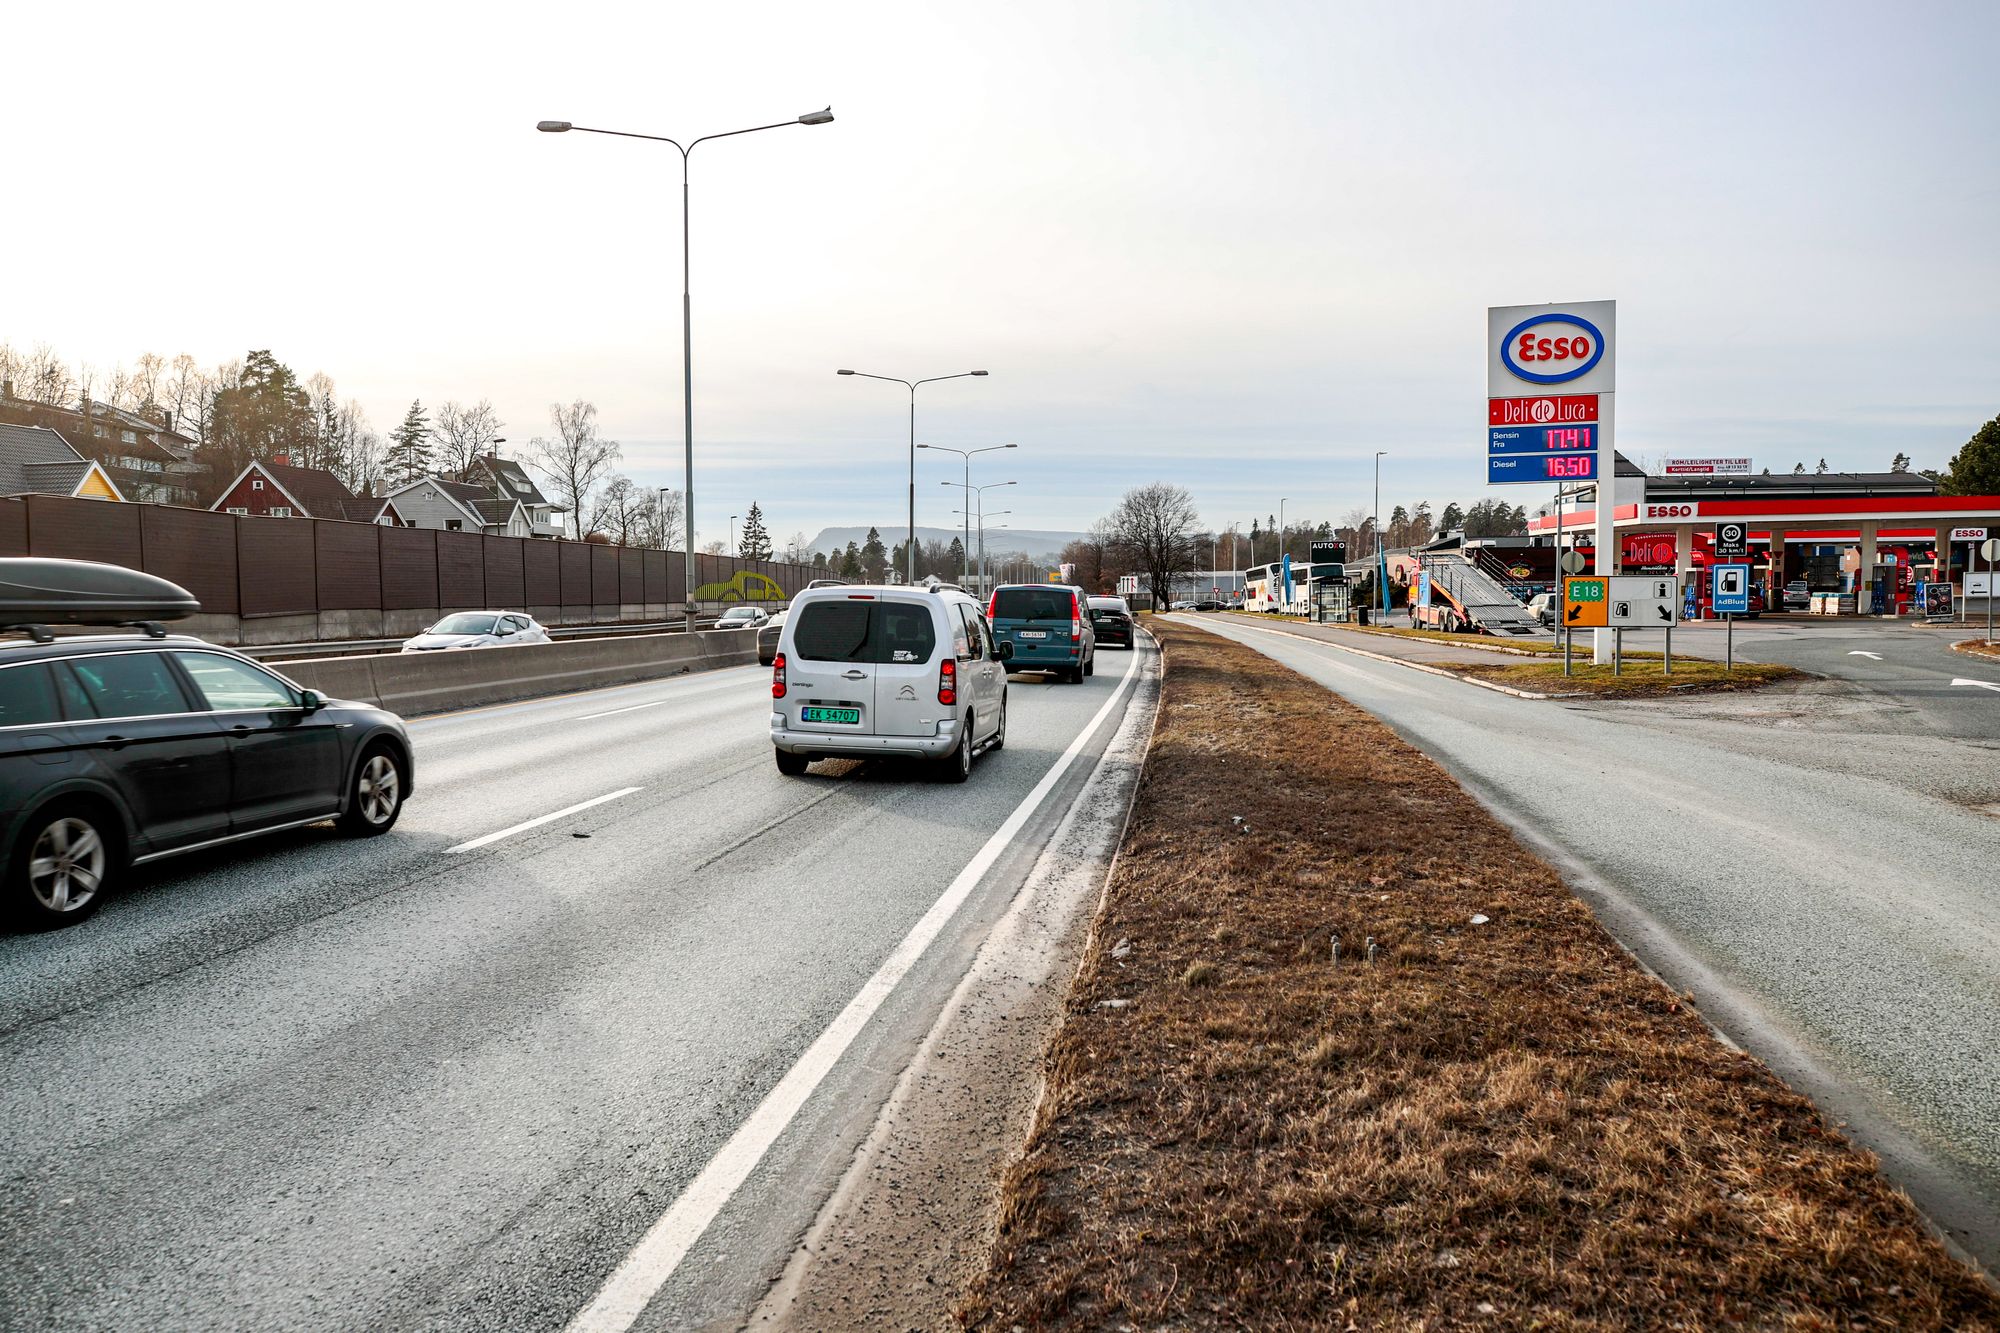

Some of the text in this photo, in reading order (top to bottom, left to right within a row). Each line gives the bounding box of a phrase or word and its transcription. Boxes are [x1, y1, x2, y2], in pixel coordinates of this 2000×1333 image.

[1518, 333, 1590, 362] Esso
[1505, 399, 1585, 422] Deli de Luca
[1547, 428, 1591, 449] 17.41
[1547, 456, 1591, 477] 16.50
[1647, 505, 1692, 518] ESSO
[1955, 529, 1984, 537] ESSO
[1630, 542, 1651, 562] Deli
[1573, 586, 1599, 597] E 18
[810, 709, 855, 721] EK 54707
